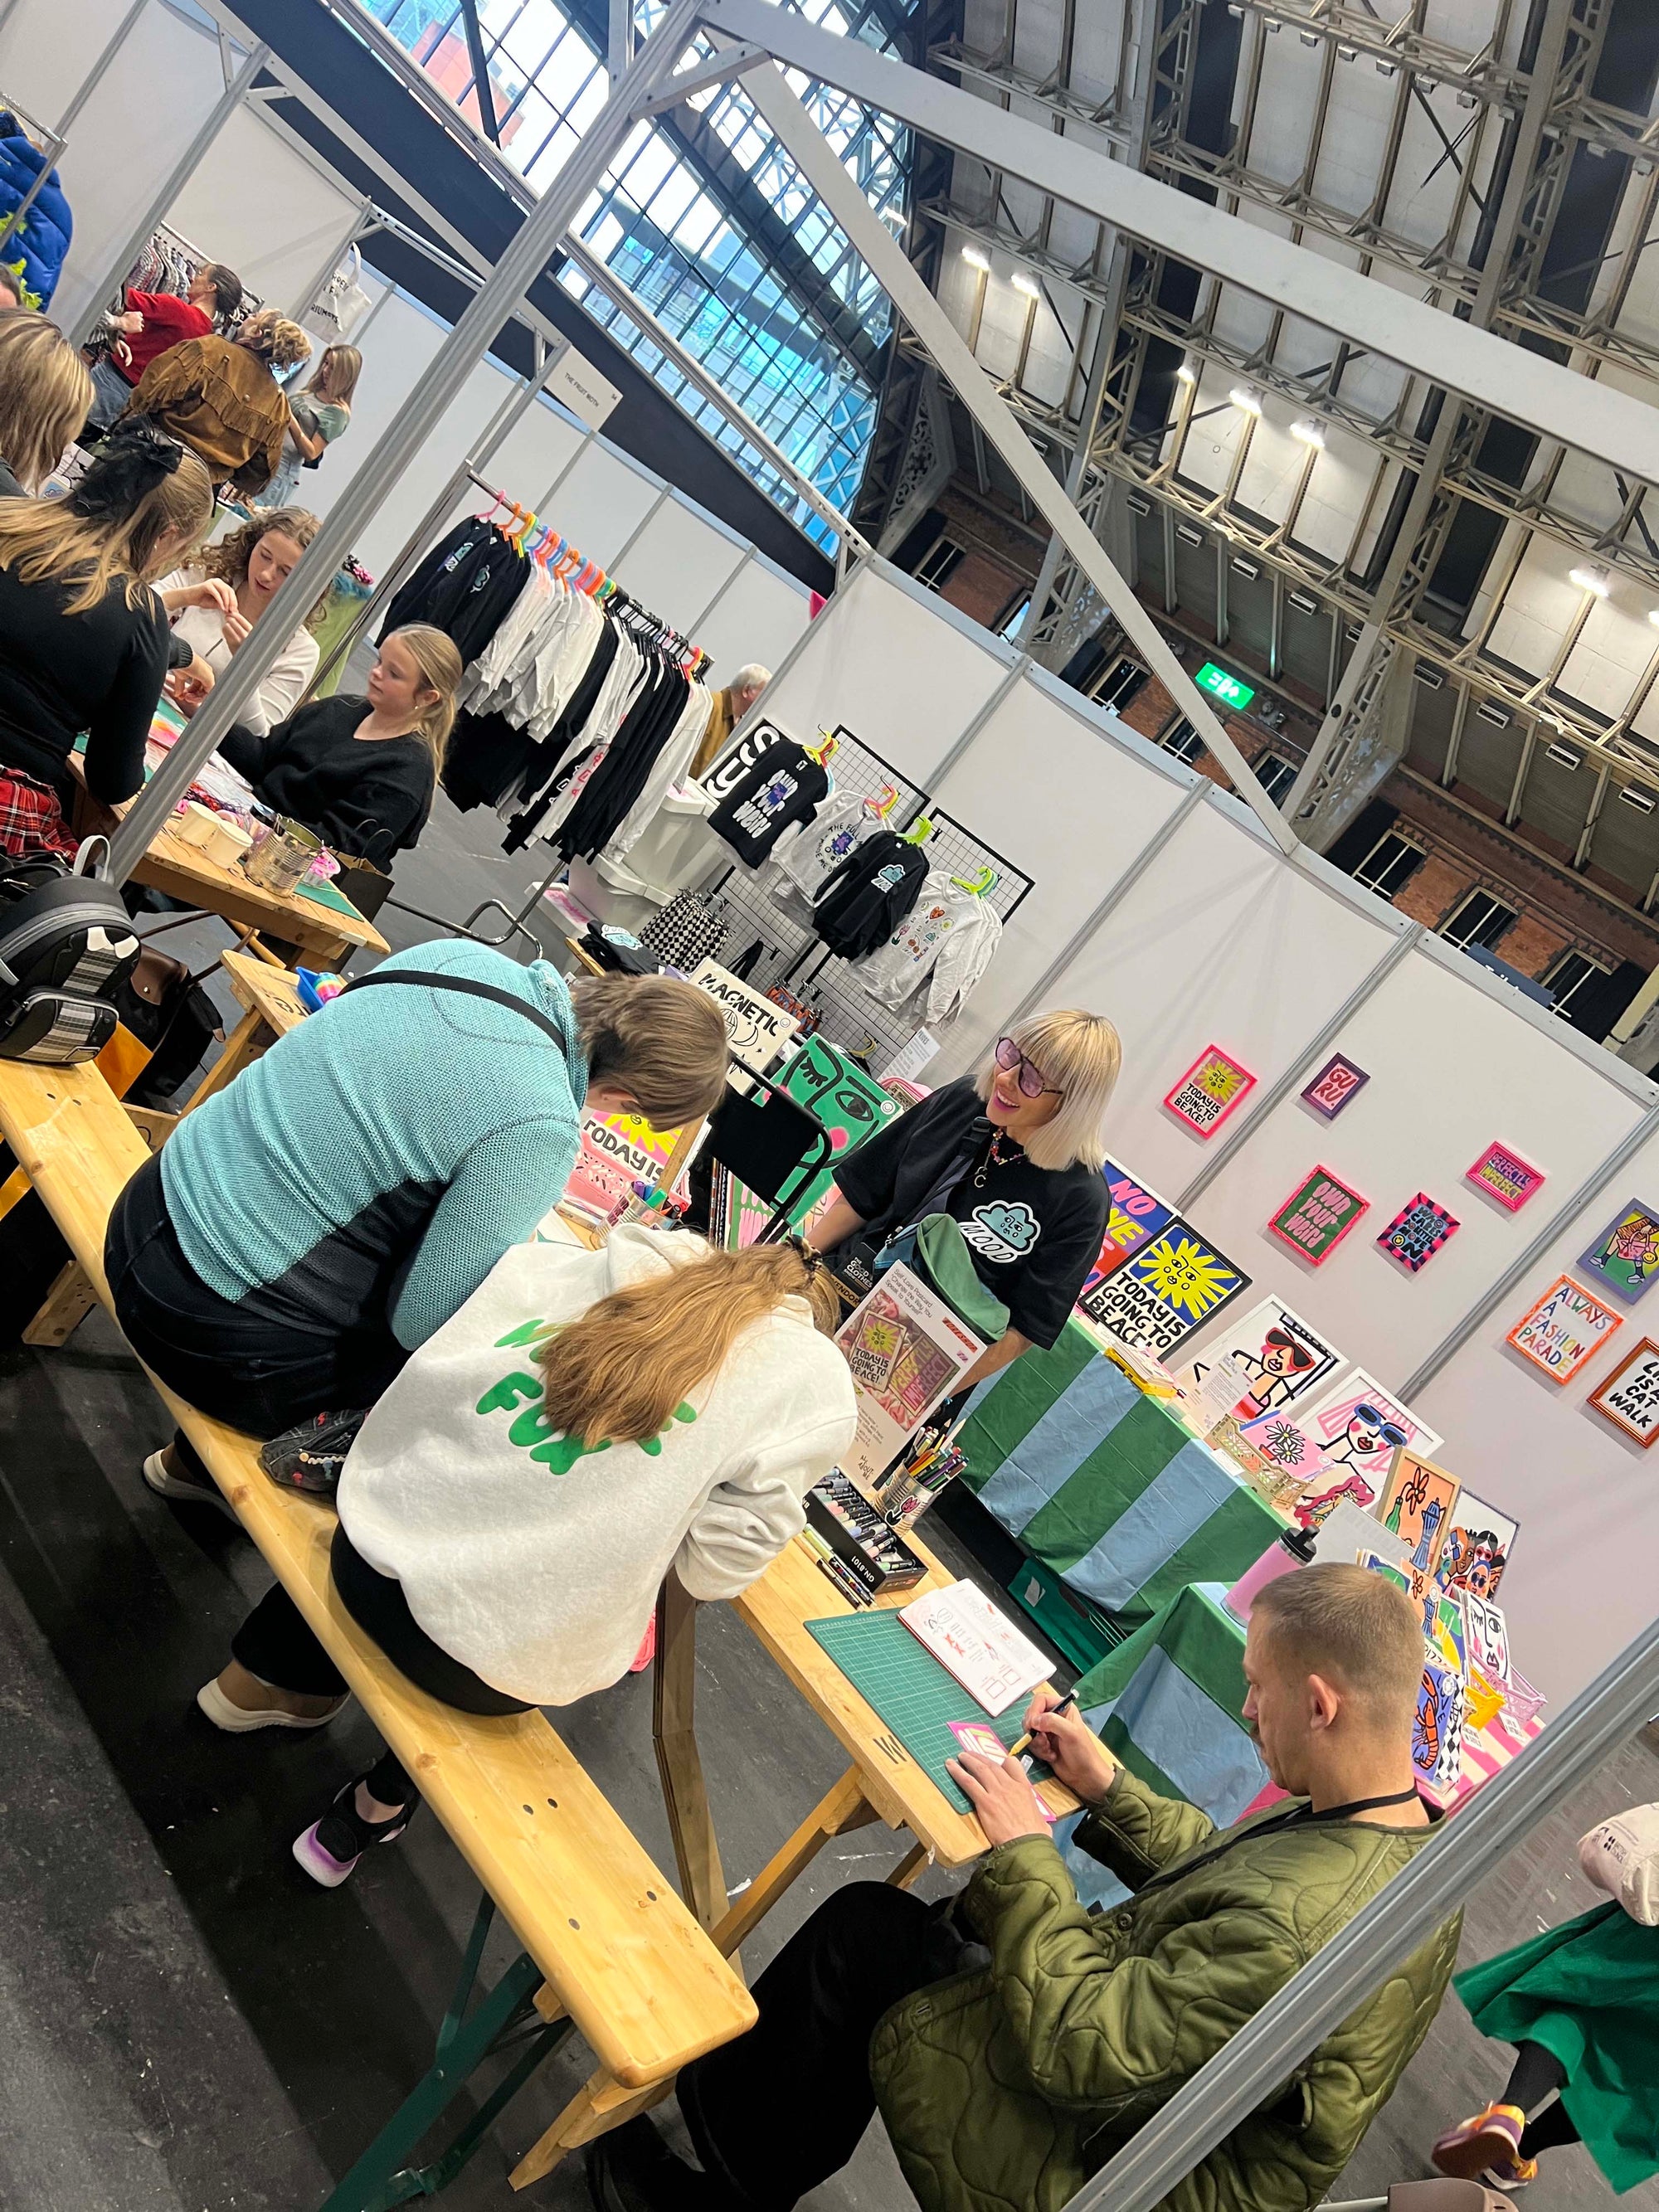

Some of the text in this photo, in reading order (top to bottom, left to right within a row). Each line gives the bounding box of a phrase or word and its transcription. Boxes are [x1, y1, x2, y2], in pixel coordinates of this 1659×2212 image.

[573, 382, 587, 396] FRUIT
[698, 973, 779, 1037] MAGNETIC
[1329, 1068, 1357, 1089] GU
[1174, 1097, 1205, 1125] BE ACE!
[1180, 1091, 1215, 1121] GOING TO
[1187, 1082, 1221, 1114] TODAY IS
[583, 1120, 648, 1171] TODAY
[1479, 1164, 1522, 1200] IMPERFECT
[1491, 1153, 1531, 1189] PERFECTLY
[1410, 1213, 1441, 1237] CARES
[960, 1225, 1014, 1260] MOOD
[847, 1265, 873, 1287] CLOTHES
[850, 1261, 869, 1276] GOOD
[914, 1287, 933, 1307] Postcard
[1088, 1295, 1117, 1322] BE
[1117, 1271, 1170, 1322] TODAY
[1162, 1315, 1186, 1336] IS
[1543, 1300, 1558, 1317] A
[1555, 1287, 1611, 1330] ALWAYS
[1102, 1286, 1172, 1348] GOING TO
[1517, 1326, 1573, 1373] PARADE
[1530, 1313, 1585, 1359] FASHION
[852, 1357, 887, 1377] GOING TO
[855, 1348, 889, 1368] TODAY IS
[861, 1369, 880, 1383] ACE!
[1634, 1374, 1654, 1390] IS
[1608, 1393, 1652, 1427] WALK
[1626, 1385, 1657, 1408] CAT
